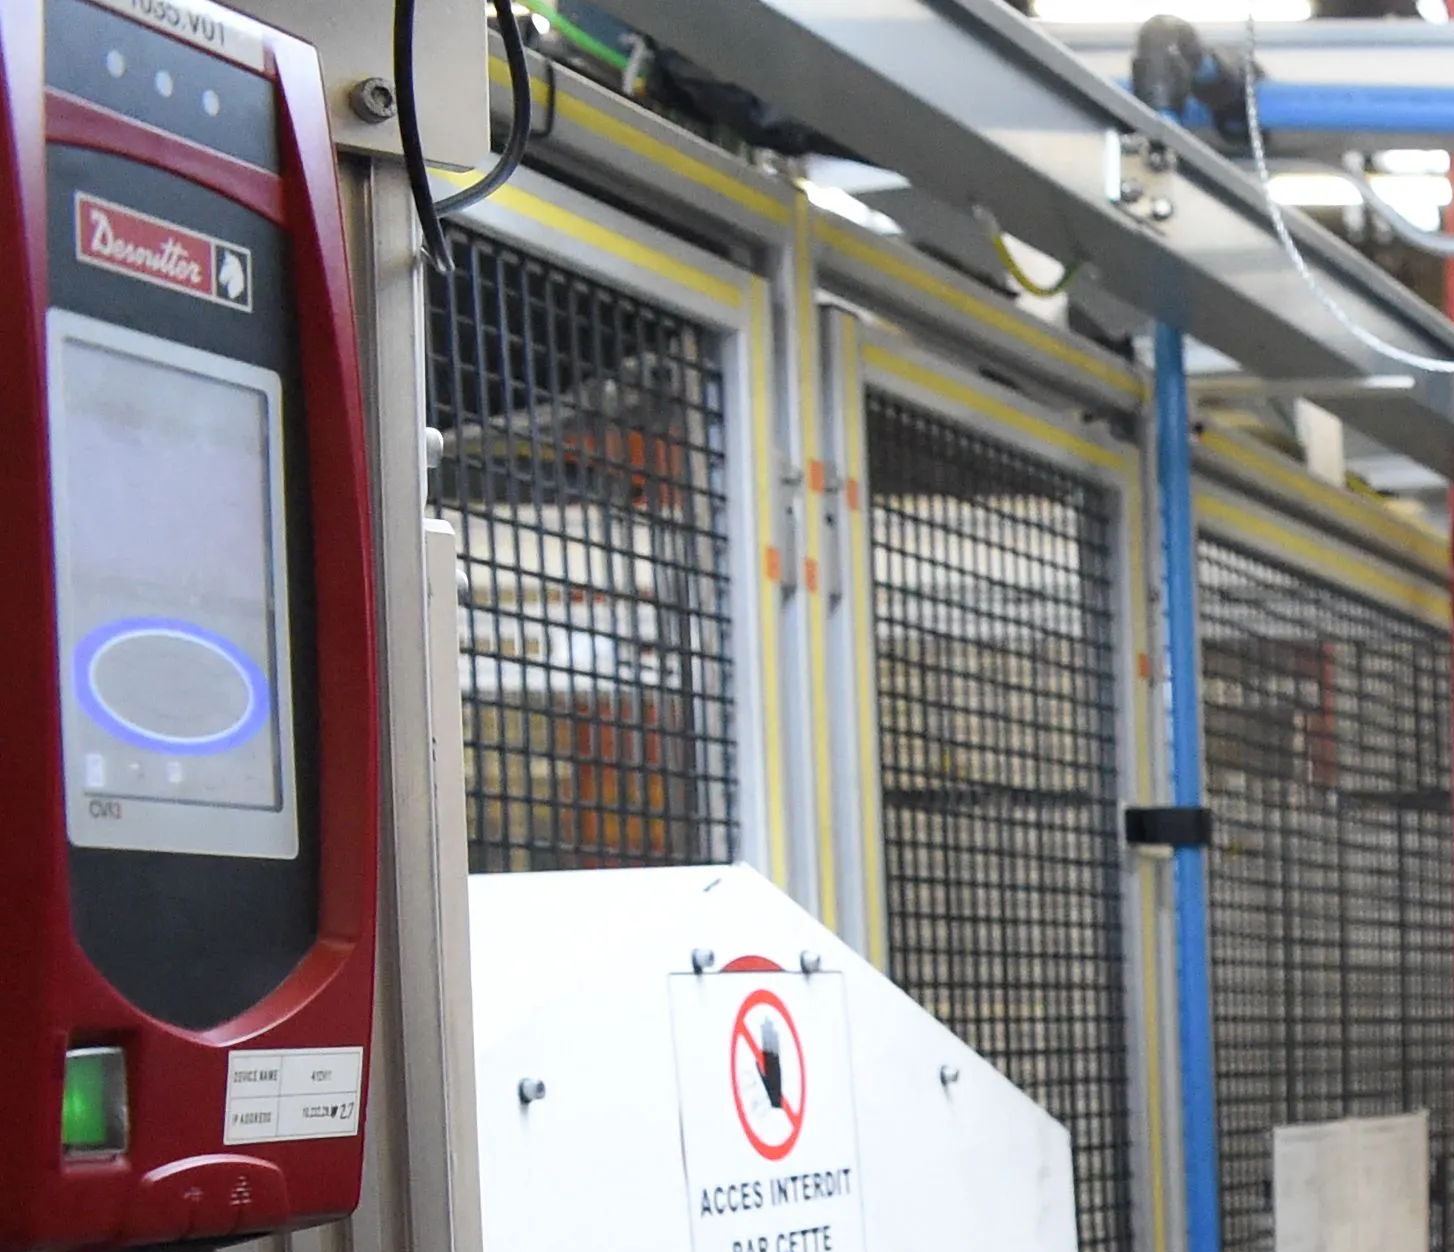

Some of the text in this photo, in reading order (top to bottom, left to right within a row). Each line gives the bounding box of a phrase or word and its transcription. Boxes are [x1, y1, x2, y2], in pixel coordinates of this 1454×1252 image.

[89, 208, 202, 284] Desoutter
[701, 1168, 851, 1217] ACCES INTERDIT
